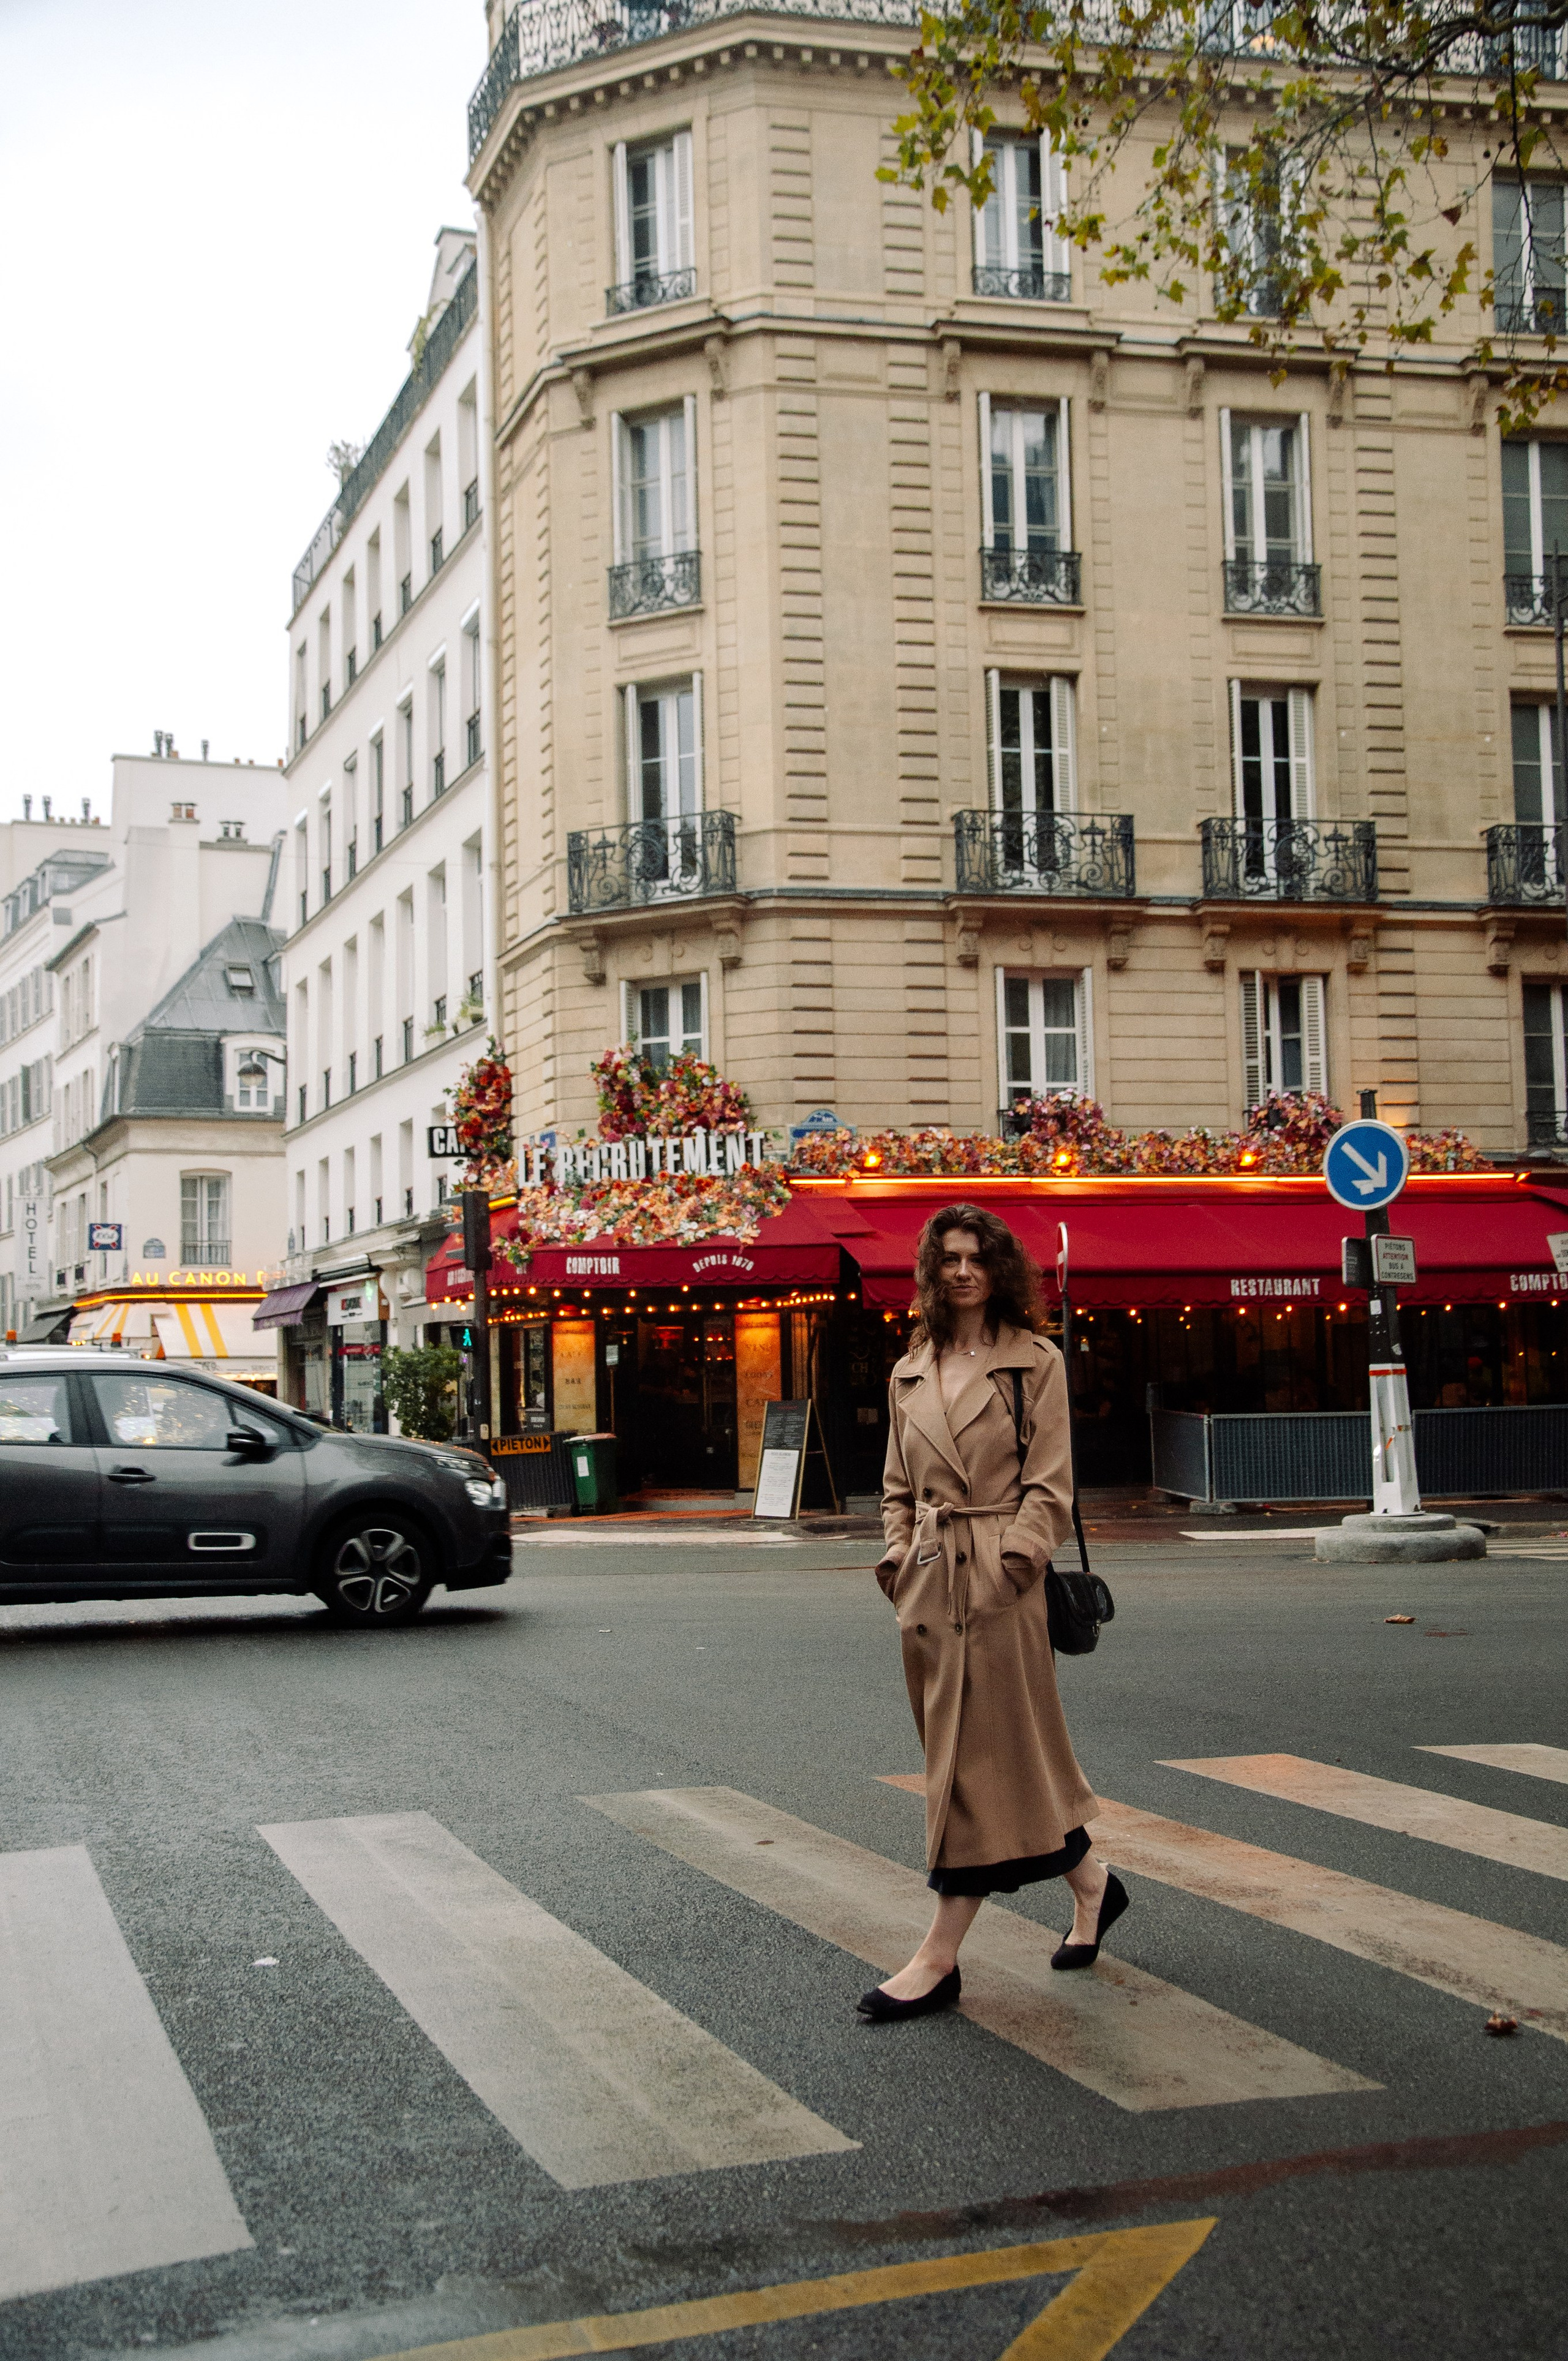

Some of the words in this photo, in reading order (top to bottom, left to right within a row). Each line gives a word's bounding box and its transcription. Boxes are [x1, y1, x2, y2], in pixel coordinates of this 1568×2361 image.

[518, 1147, 547, 1187] LE
[26, 1202, 37, 1273] HOTEL
[566, 1257, 620, 1274] COMPTOIR
[692, 1254, 727, 1273] DEPUIS
[731, 1255, 754, 1271] 1870
[131, 1271, 159, 1286] AU
[168, 1271, 246, 1286] CANON
[1231, 1278, 1320, 1296] RESTAURANT
